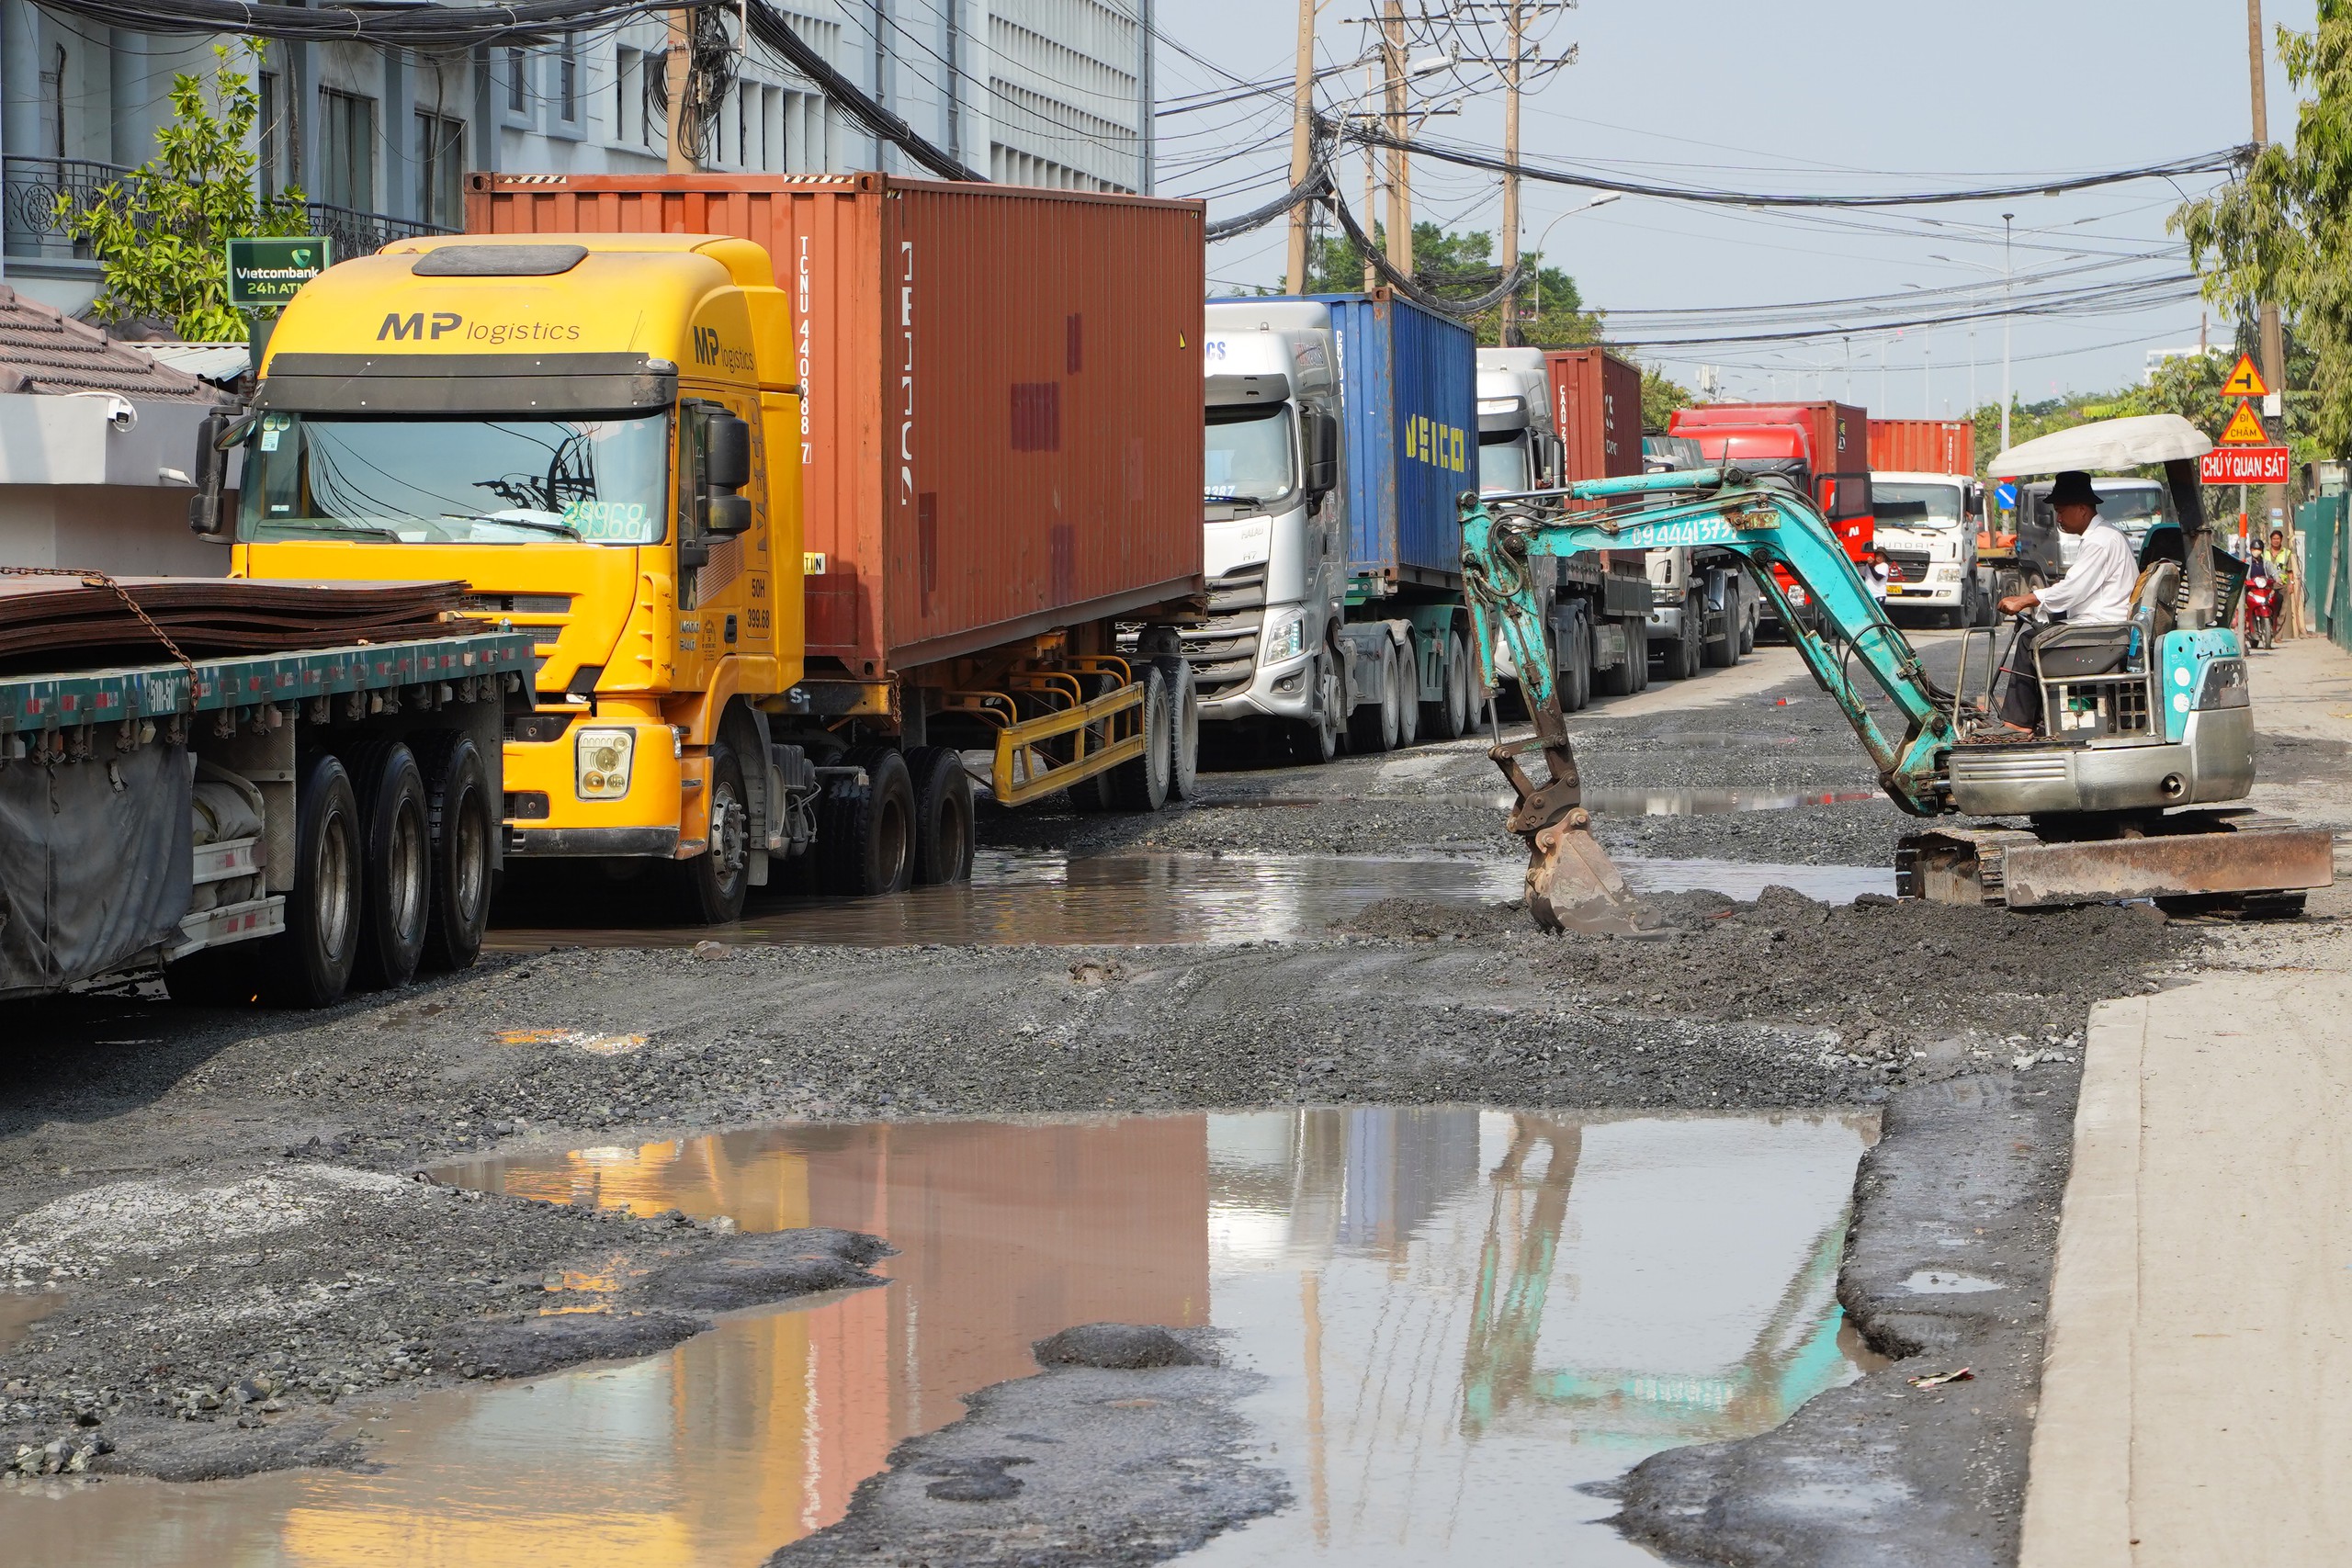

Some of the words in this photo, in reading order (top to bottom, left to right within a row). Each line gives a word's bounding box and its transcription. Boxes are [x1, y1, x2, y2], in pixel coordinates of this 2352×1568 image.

[236, 266, 320, 279] Vietcombank
[799, 235, 808, 313] TCNU
[247, 282, 277, 295] 24h
[377, 312, 463, 341] MP
[467, 321, 581, 345] logistics
[694, 325, 719, 367] MP
[719, 342, 754, 374] logistics
[2239, 413, 2249, 423] ĐI
[2202, 451, 2224, 477] CHÚ
[2223, 451, 2233, 477] Ý
[2233, 456, 2262, 477] QUAN
[2264, 451, 2286, 477] SÁT
[752, 578, 766, 598] 50H
[747, 608, 771, 629] 399.68
